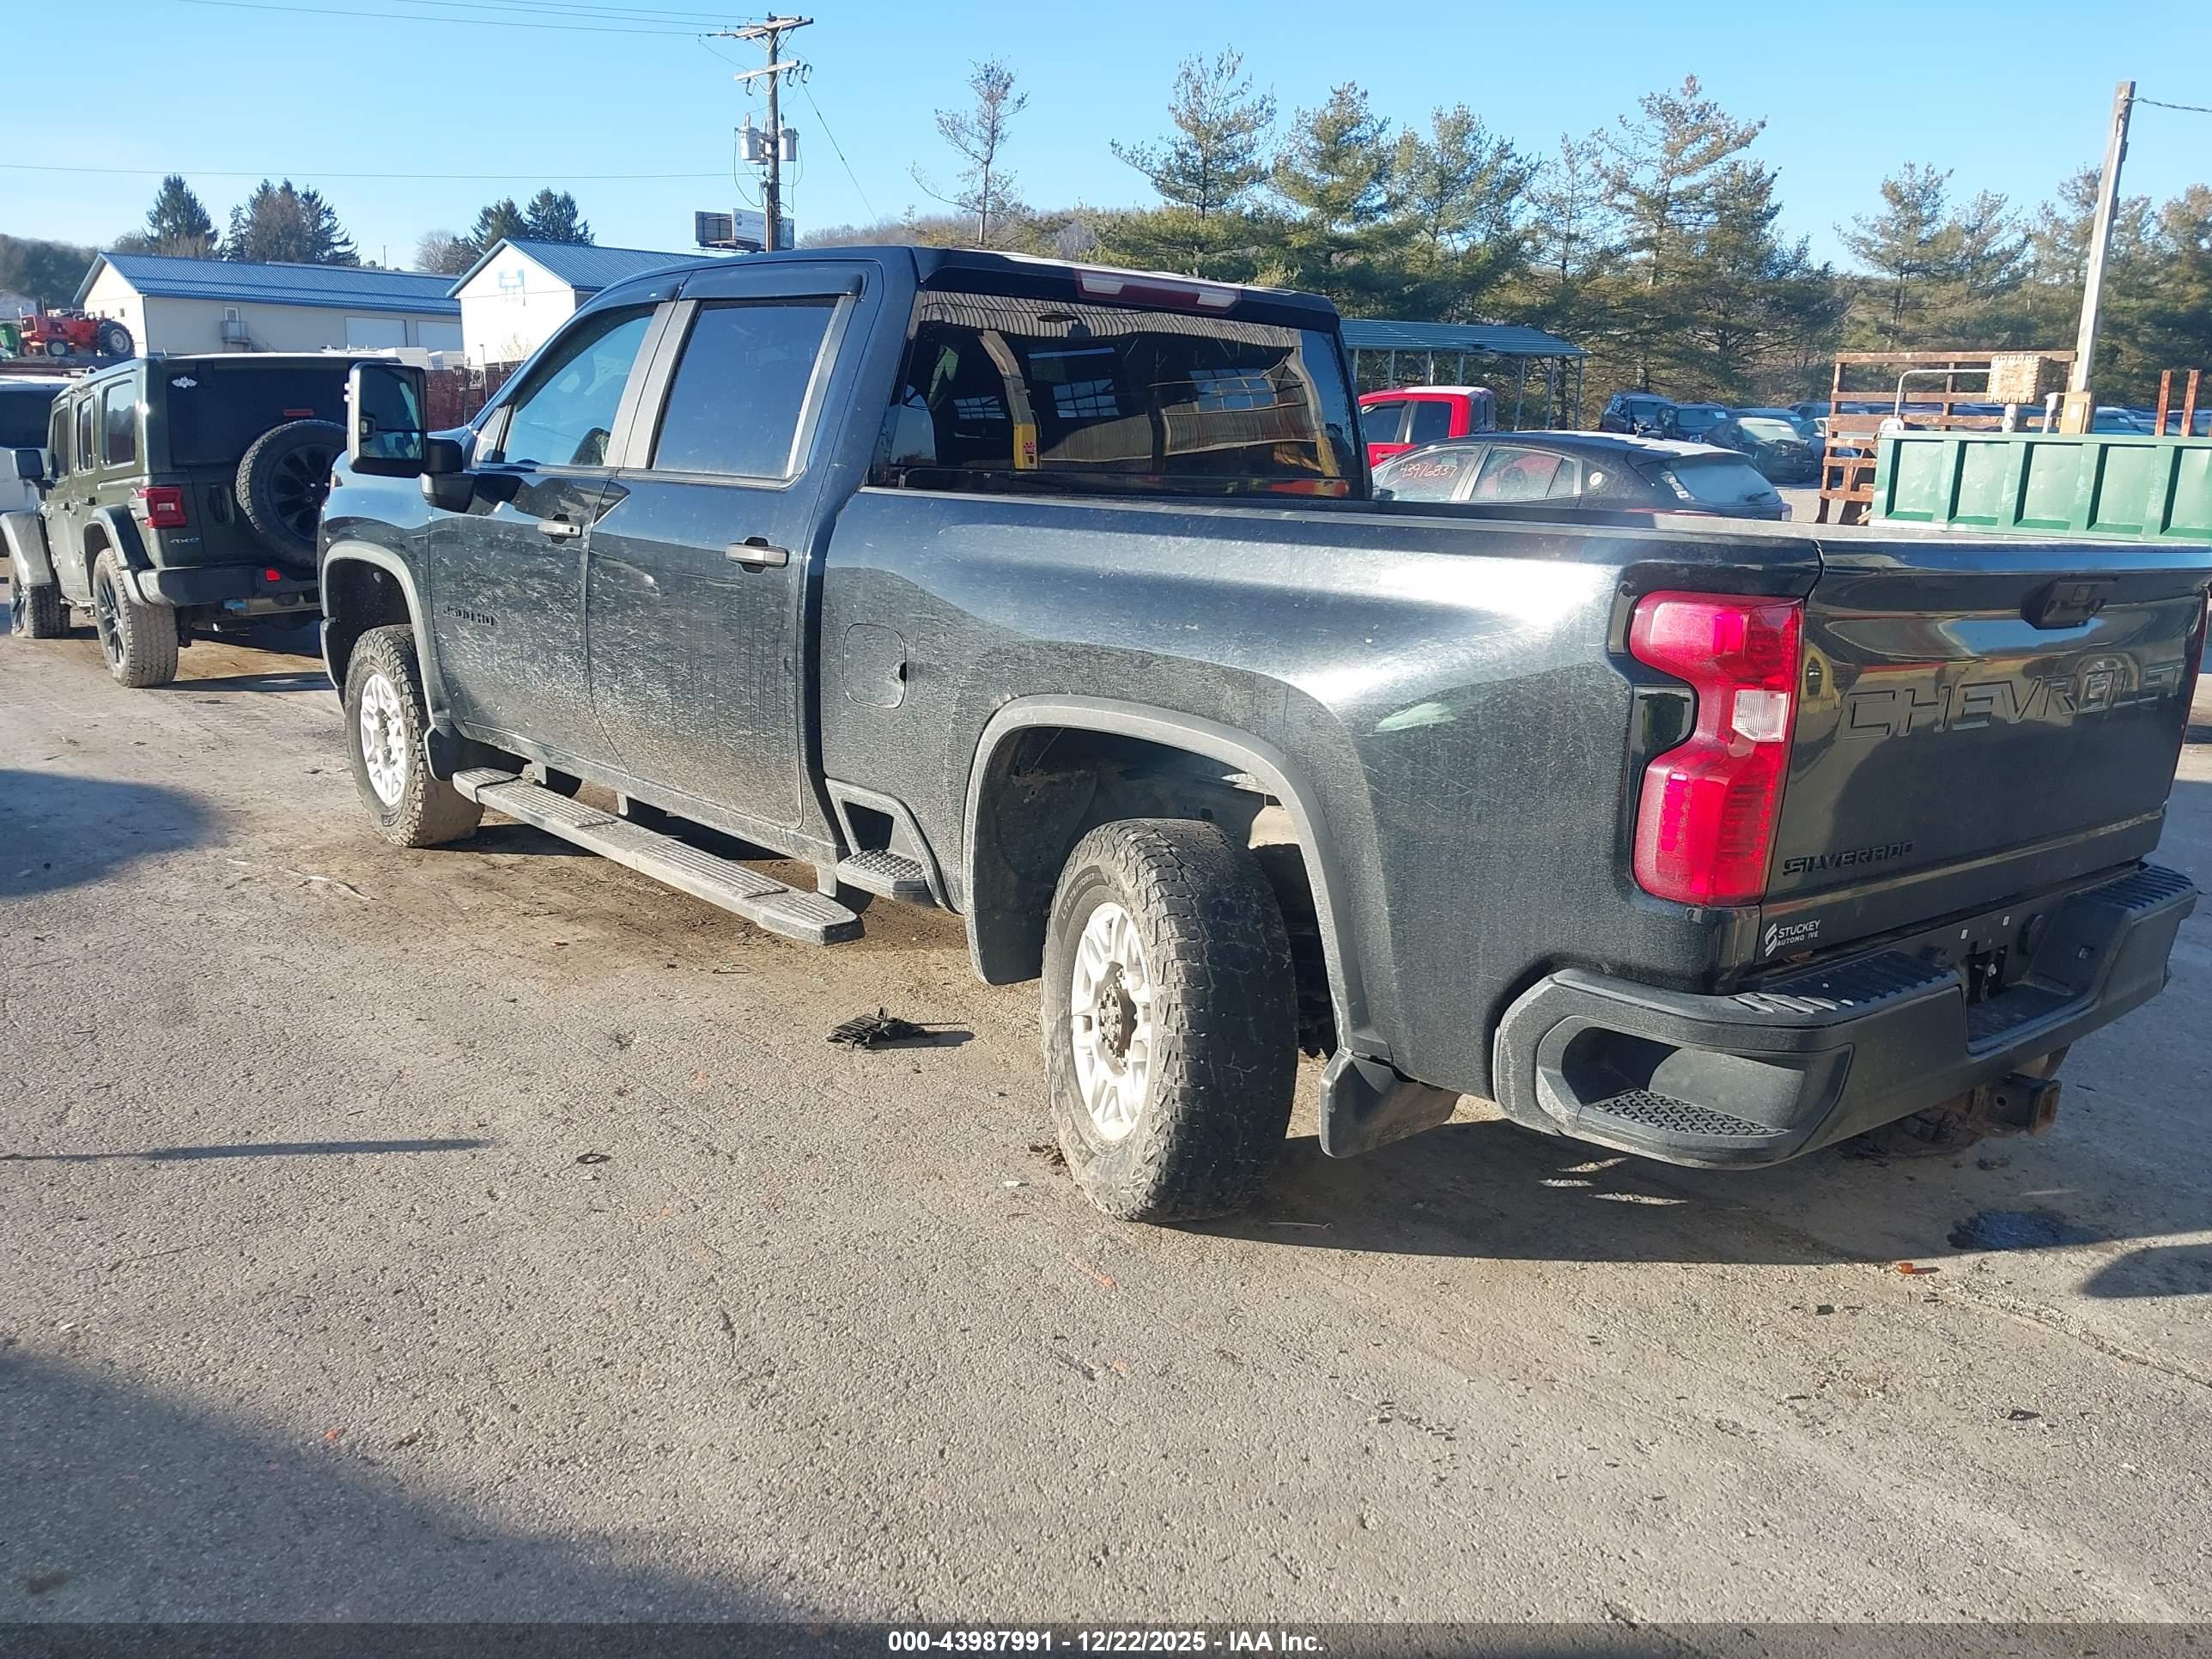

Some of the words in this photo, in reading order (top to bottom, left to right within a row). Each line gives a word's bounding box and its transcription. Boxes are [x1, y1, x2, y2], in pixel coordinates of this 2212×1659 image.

[1841, 658, 2185, 740] CHEVROLET
[1783, 840, 1914, 876] SILVERADO
[1777, 930, 1820, 947] AUTOMOIVE
[1778, 919, 1820, 939] STUCKEY
